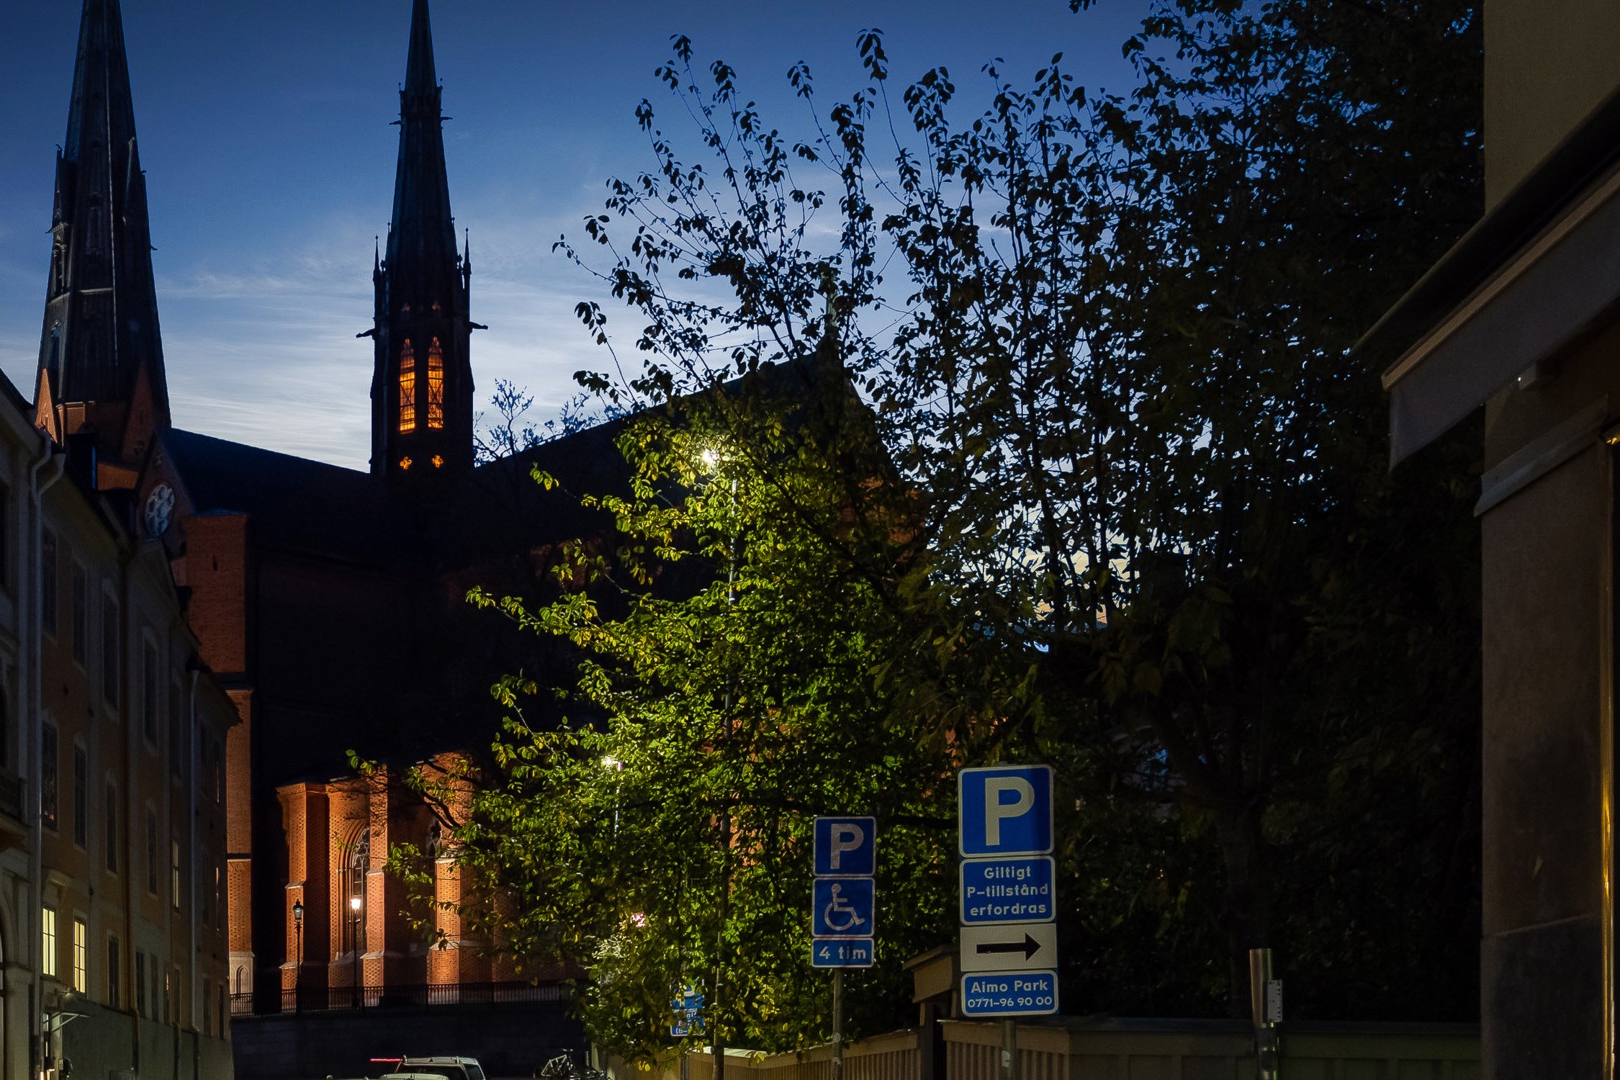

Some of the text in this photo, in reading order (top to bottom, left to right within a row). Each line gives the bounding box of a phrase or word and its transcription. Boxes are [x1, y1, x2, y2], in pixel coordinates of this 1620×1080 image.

[985, 776, 1035, 847] P
[830, 823, 864, 870] P
[984, 866, 1031, 880] Giltigt
[967, 883, 1049, 898] P-tillstånd
[970, 903, 1046, 917] erfordras
[819, 946, 867, 960] 4 tim
[971, 979, 1049, 993] Aimo Park
[967, 995, 1053, 1008] 0771-96 90 00
